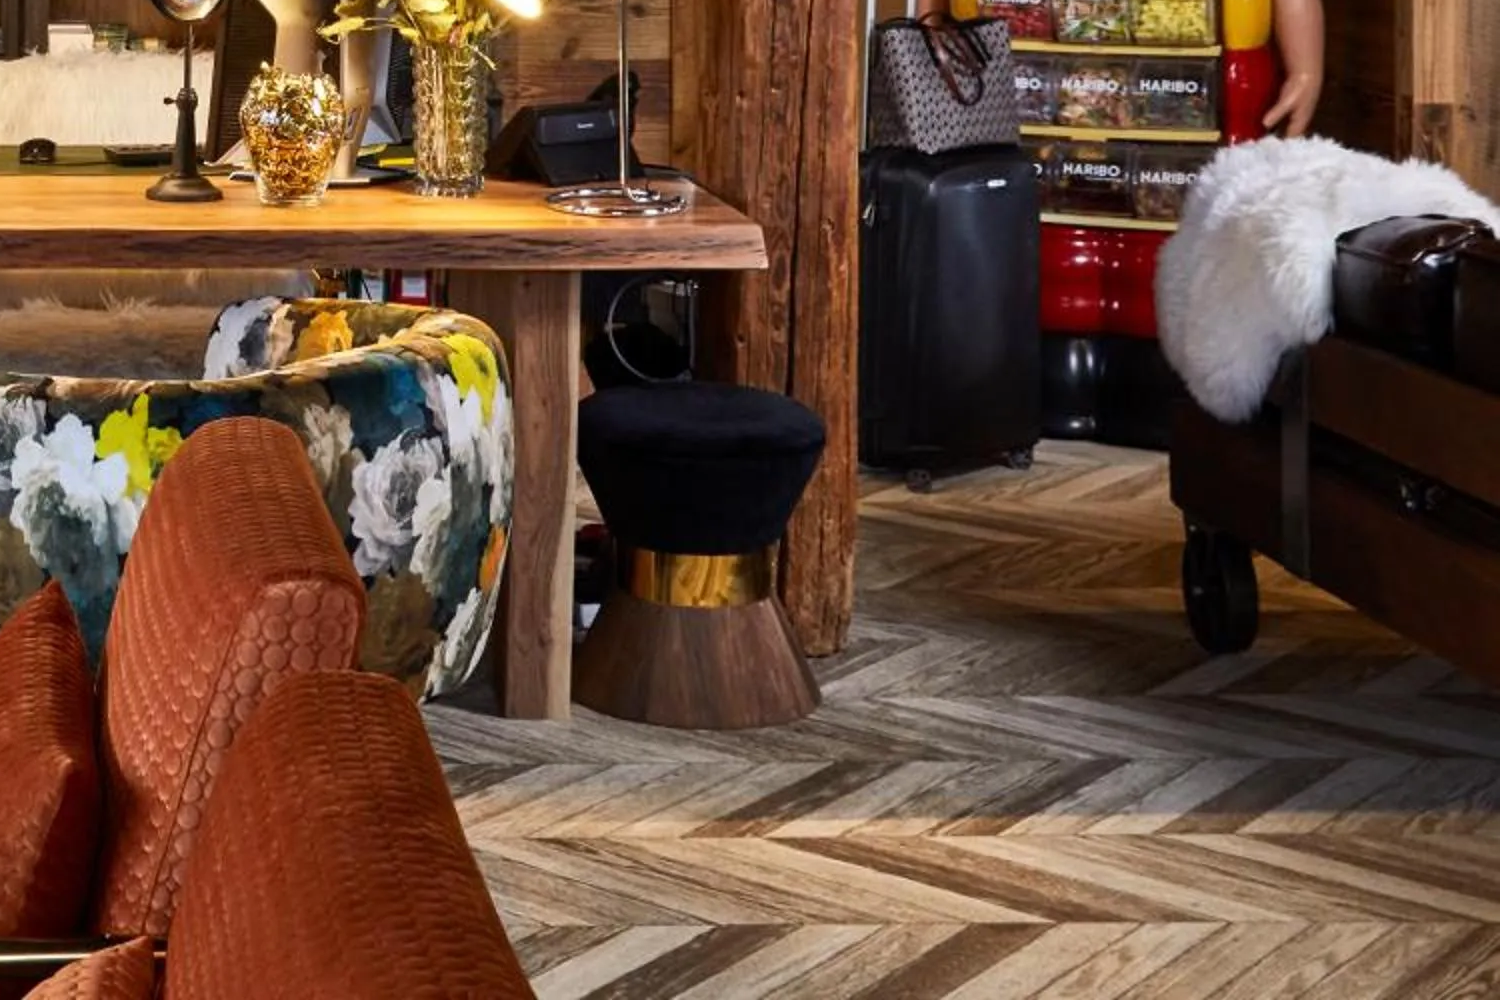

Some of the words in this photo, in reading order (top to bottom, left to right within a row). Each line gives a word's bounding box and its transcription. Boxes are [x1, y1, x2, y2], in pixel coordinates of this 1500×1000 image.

[1061, 77, 1119, 92] HARIBO
[1139, 79, 1199, 93] HARIBO
[1062, 162, 1121, 177] HARIBO
